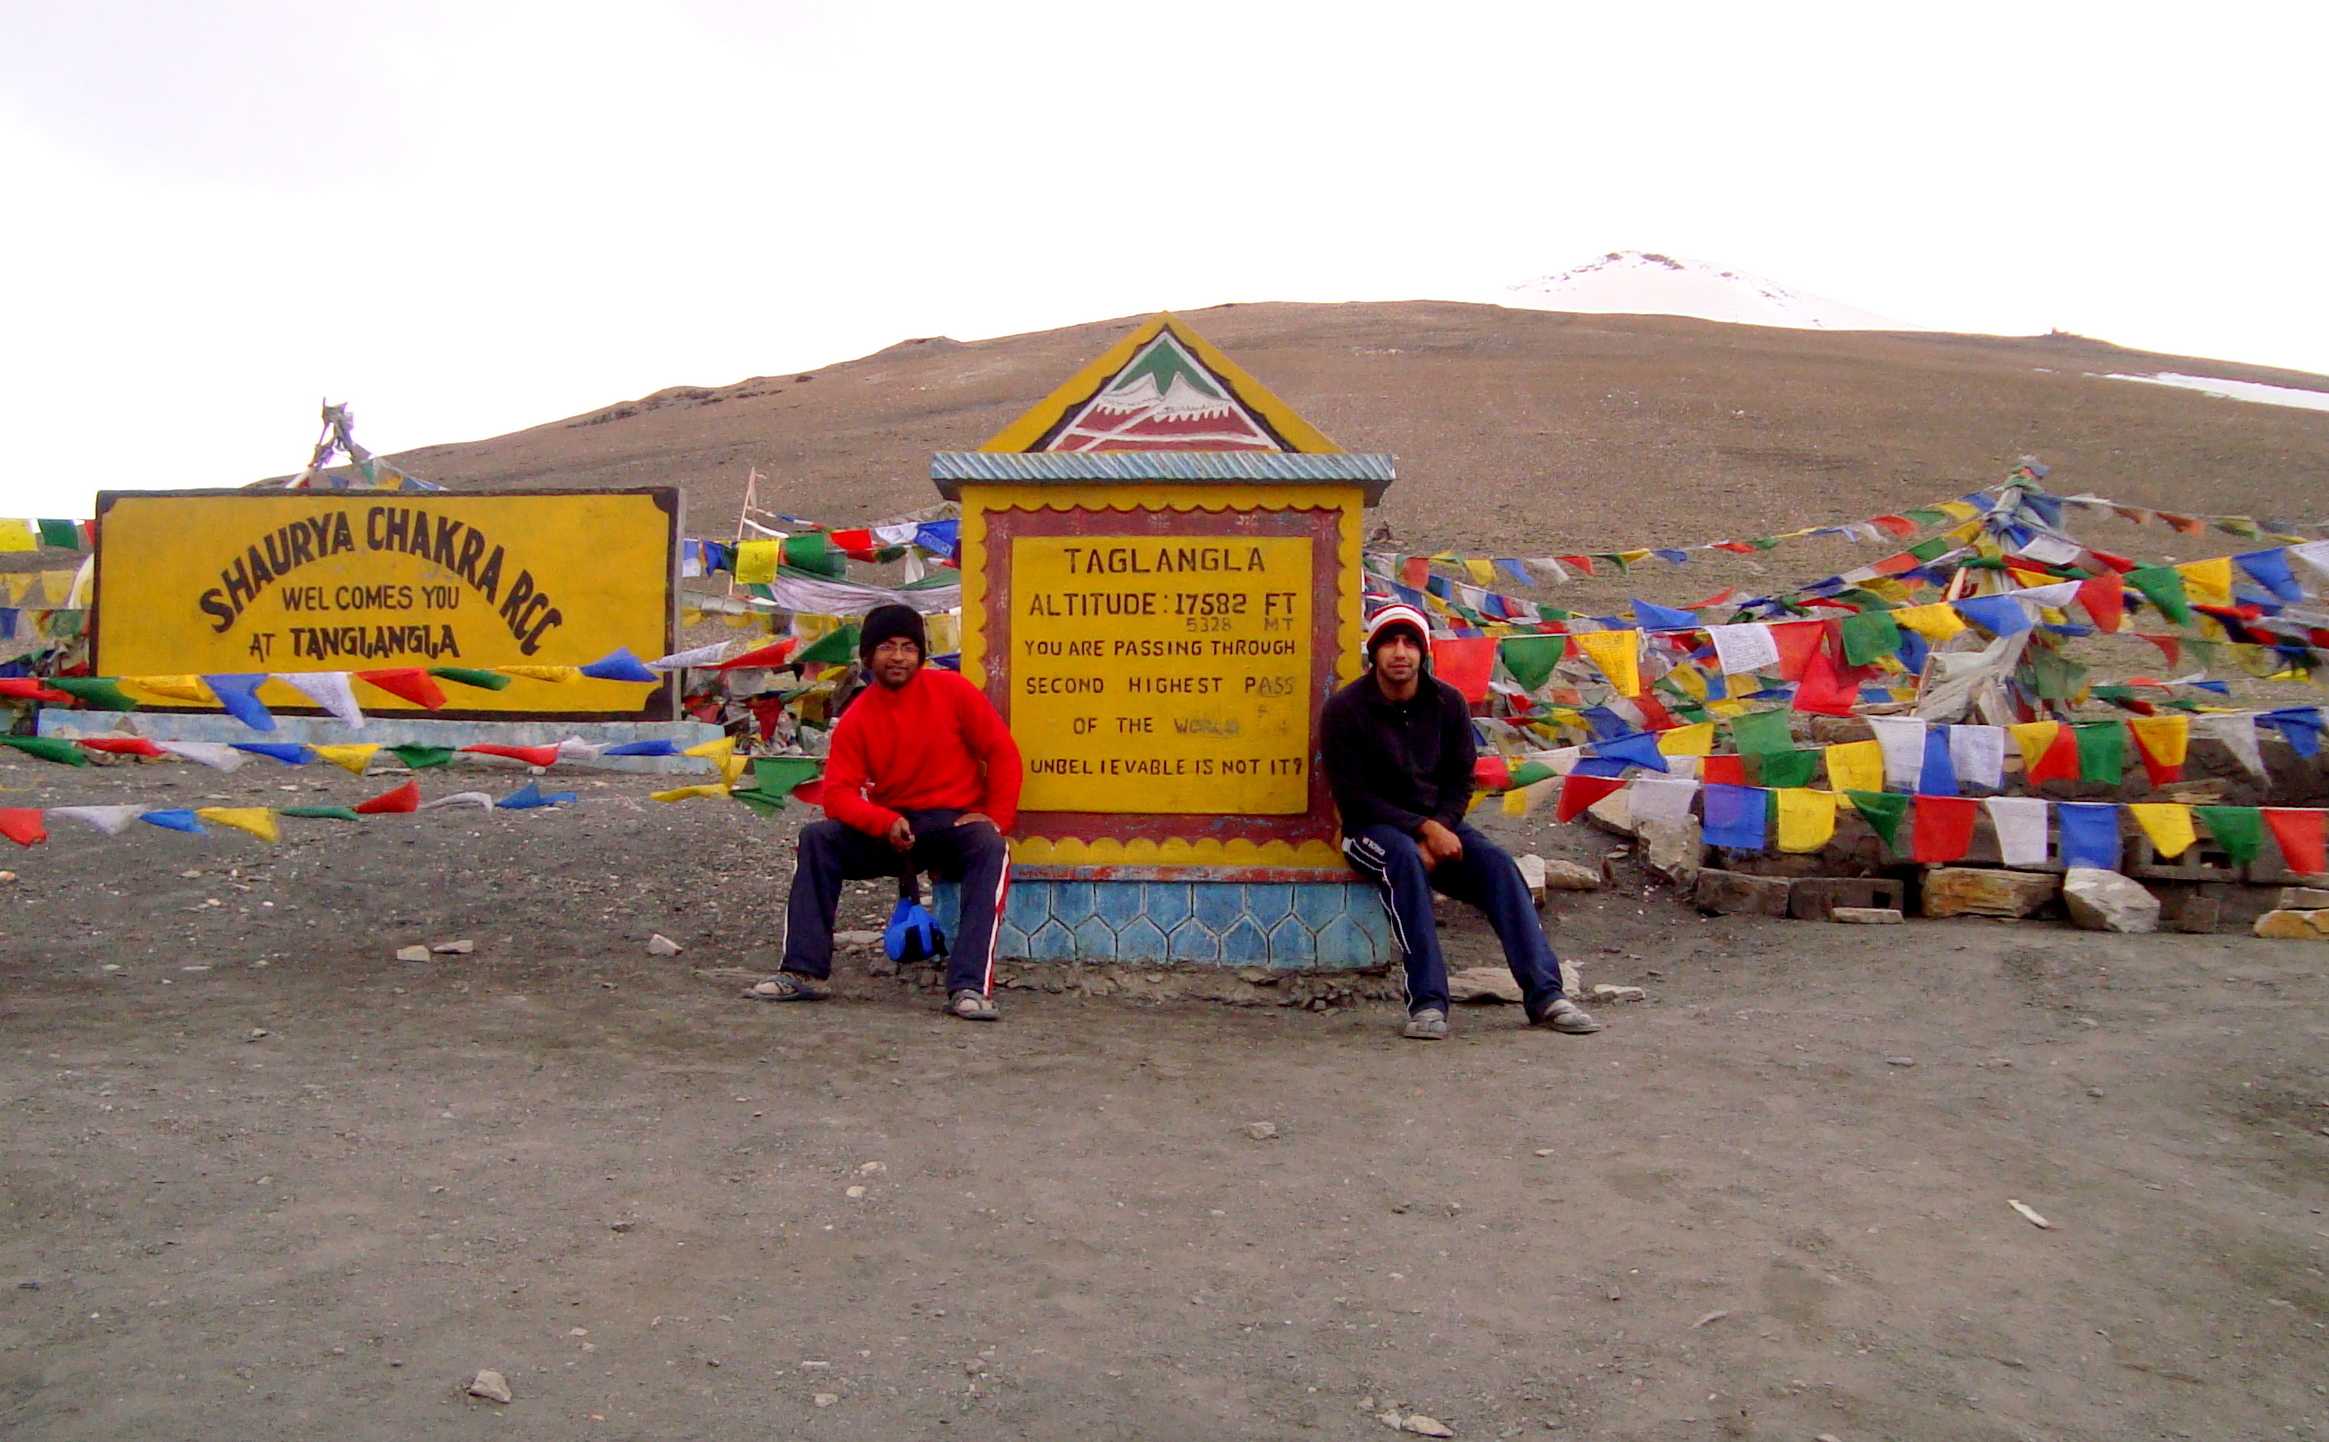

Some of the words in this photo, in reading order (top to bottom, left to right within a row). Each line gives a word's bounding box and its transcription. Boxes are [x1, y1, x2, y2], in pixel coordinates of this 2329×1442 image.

[1064, 547, 1266, 574] TAGLANGLA
[199, 510, 355, 634] SHAURYA
[367, 506, 506, 604] CHAKRA
[500, 569, 564, 656] RCC
[280, 585, 414, 611] WELCOMES
[421, 584, 460, 609] YOU
[1264, 592, 1297, 616] FT
[1186, 617, 1232, 632] 5328
[1264, 618, 1294, 631] MT
[249, 633, 276, 661] AT
[290, 624, 461, 659] TANGLANGLA
[1025, 640, 1062, 656] YOU
[1069, 640, 1104, 656] ARE
[1114, 640, 1202, 656] PASSING
[1211, 640, 1295, 656] THROUGH
[1026, 677, 1104, 695] SECOND
[1128, 676, 1223, 694] HIGHEST
[1245, 675, 1295, 695] PASS
[1073, 717, 1098, 735] OF
[1117, 717, 1153, 733] THE
[1030, 758, 1185, 776] UNBELIEVABLE
[1195, 758, 1213, 775] IS
[1222, 758, 1260, 774] NOT
[1270, 758, 1302, 776] IT?
